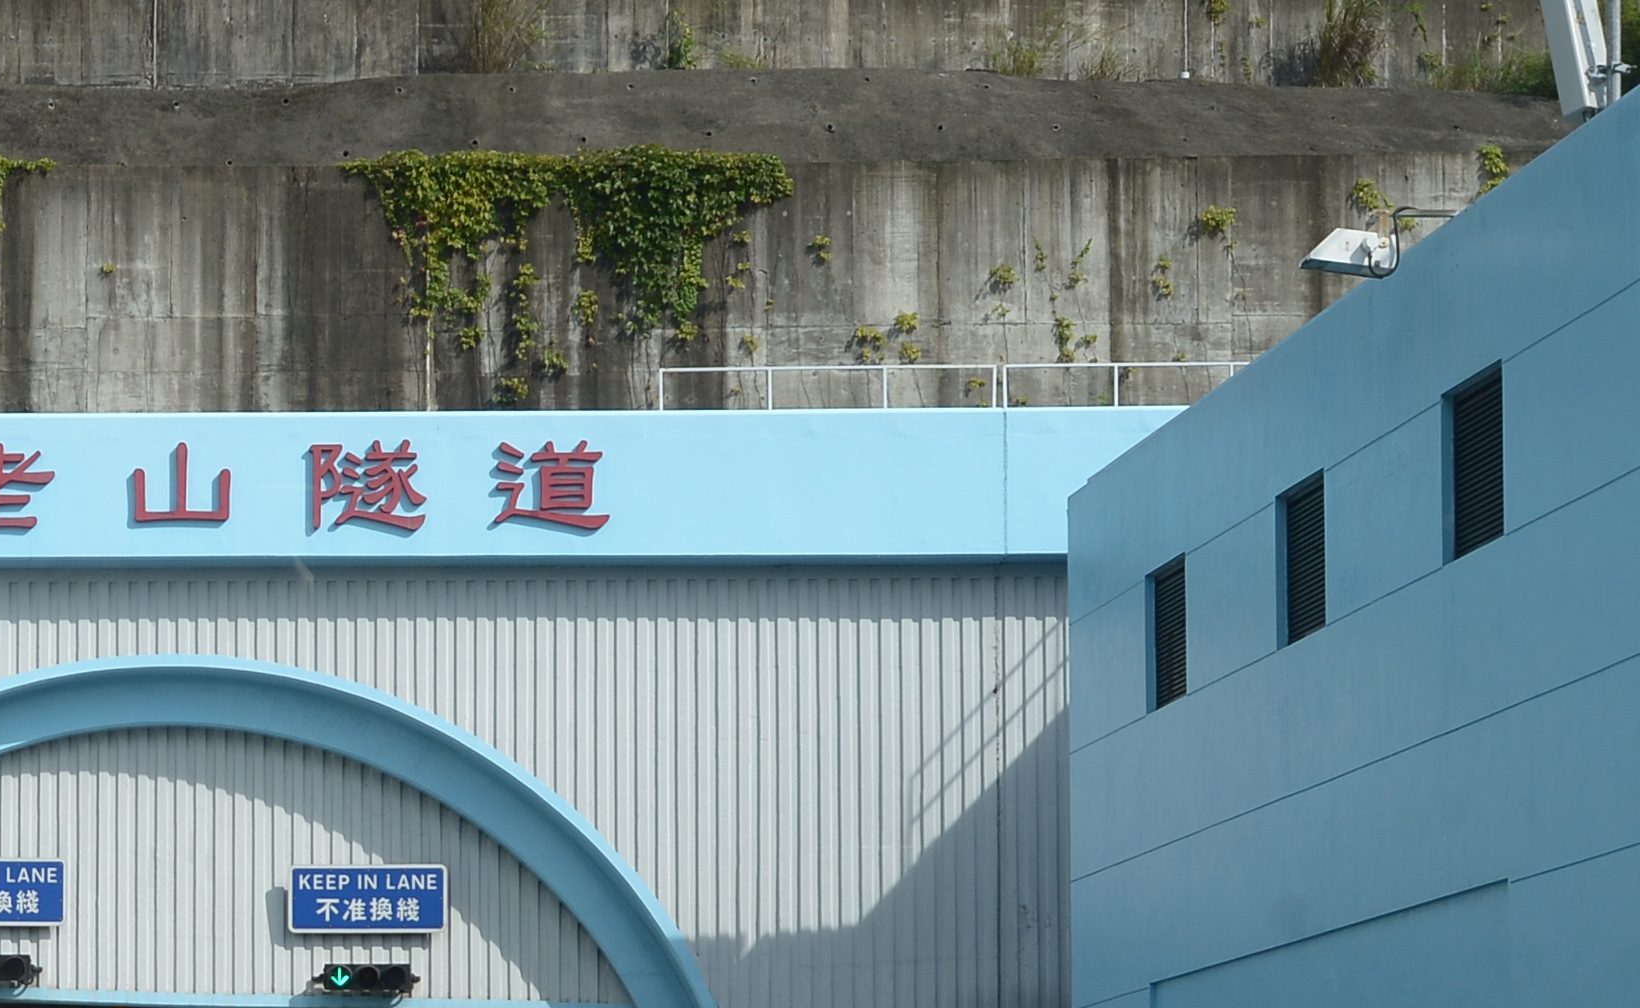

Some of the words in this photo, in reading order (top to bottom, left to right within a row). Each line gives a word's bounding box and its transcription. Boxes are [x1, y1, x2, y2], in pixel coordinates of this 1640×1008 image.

[6, 867, 58, 884] LANE
[298, 874, 350, 890] KEEP
[358, 874, 378, 890] IN
[386, 874, 438, 890] LANE
